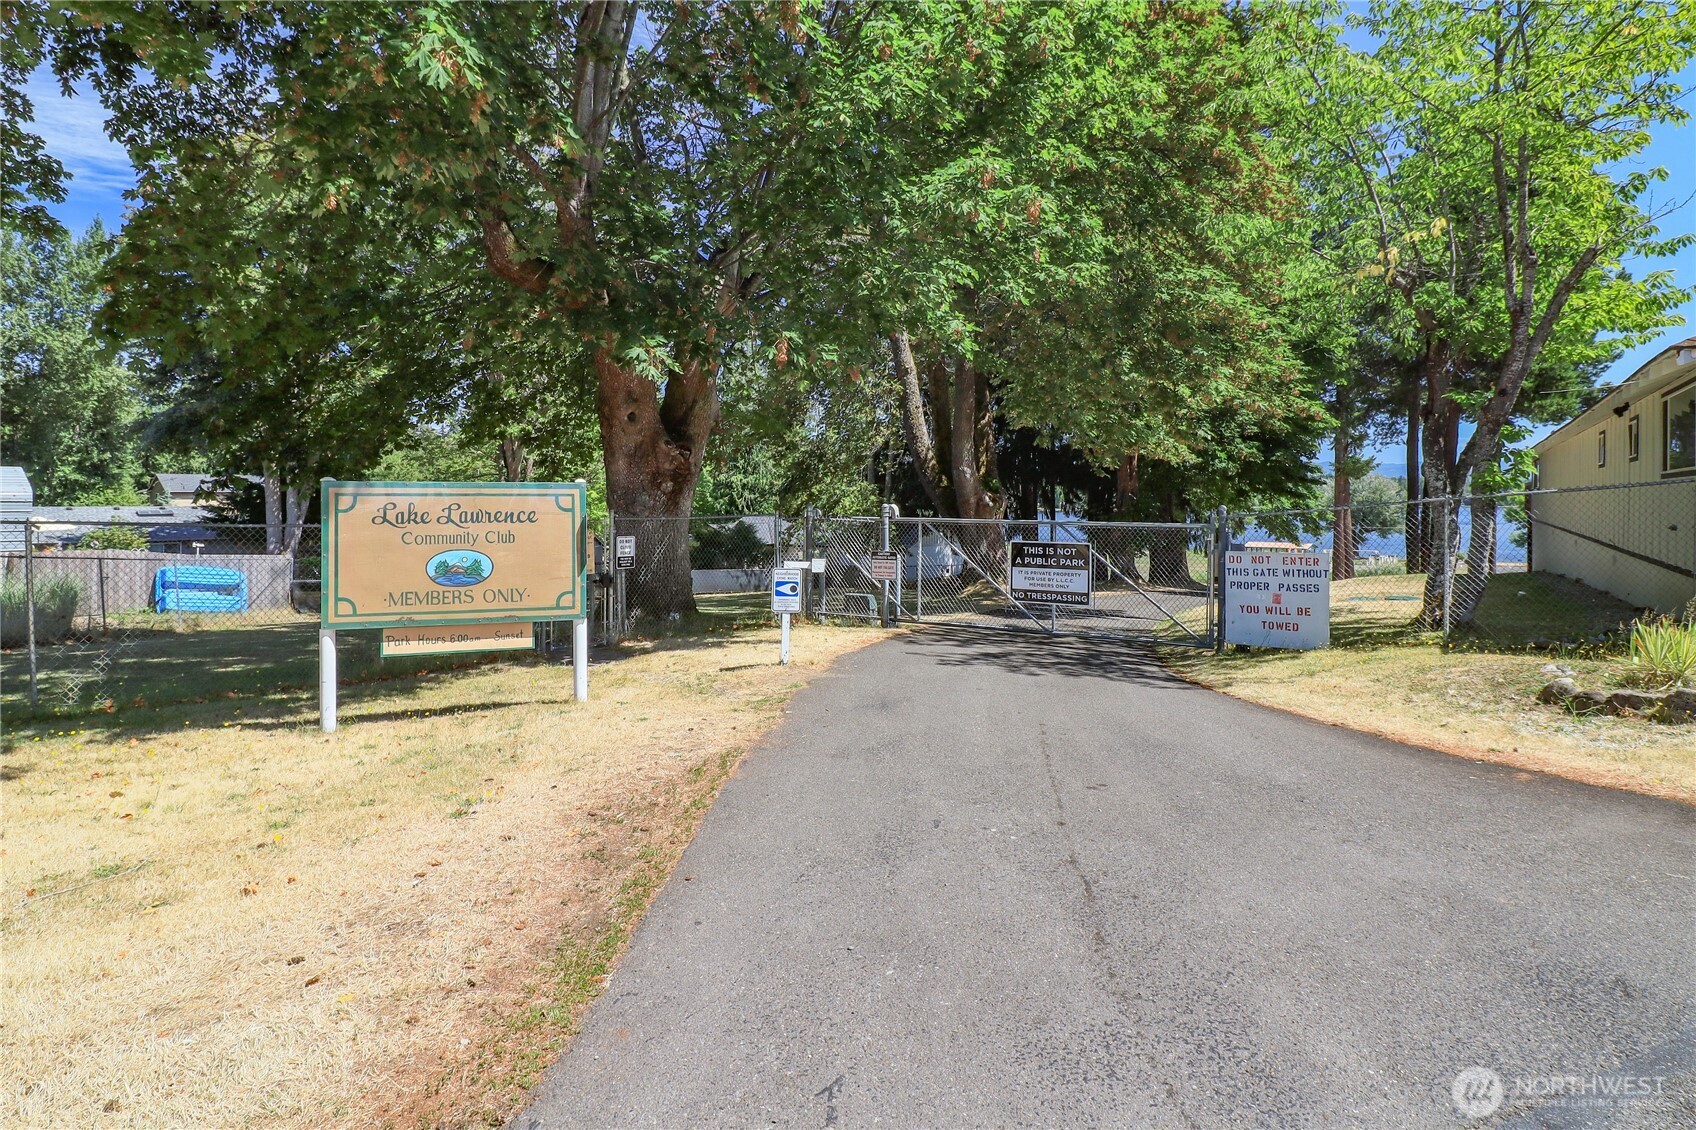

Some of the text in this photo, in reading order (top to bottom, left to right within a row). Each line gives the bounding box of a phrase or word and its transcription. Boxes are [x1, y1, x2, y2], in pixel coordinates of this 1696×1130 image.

[371, 502, 539, 529] Lake Lawrence
[401, 530, 516, 547] Community Club
[1023, 546, 1077, 556] THIS IS NOT
[1024, 557, 1057, 565] PUBLIC
[1060, 559, 1085, 567] PARK
[1228, 555, 1320, 566] DO NOT ENTER
[1226, 568, 1330, 578] THIS GATE WITHOUT
[1230, 581, 1320, 592] PROPER PASSES
[1027, 592, 1087, 602] TRESSPASSING
[1240, 605, 1312, 616] YOU WILL BE
[1262, 621, 1300, 632] TOWED
[385, 634, 411, 647] Park
[417, 633, 447, 646] Hours
[493, 628, 524, 641] Sunset
